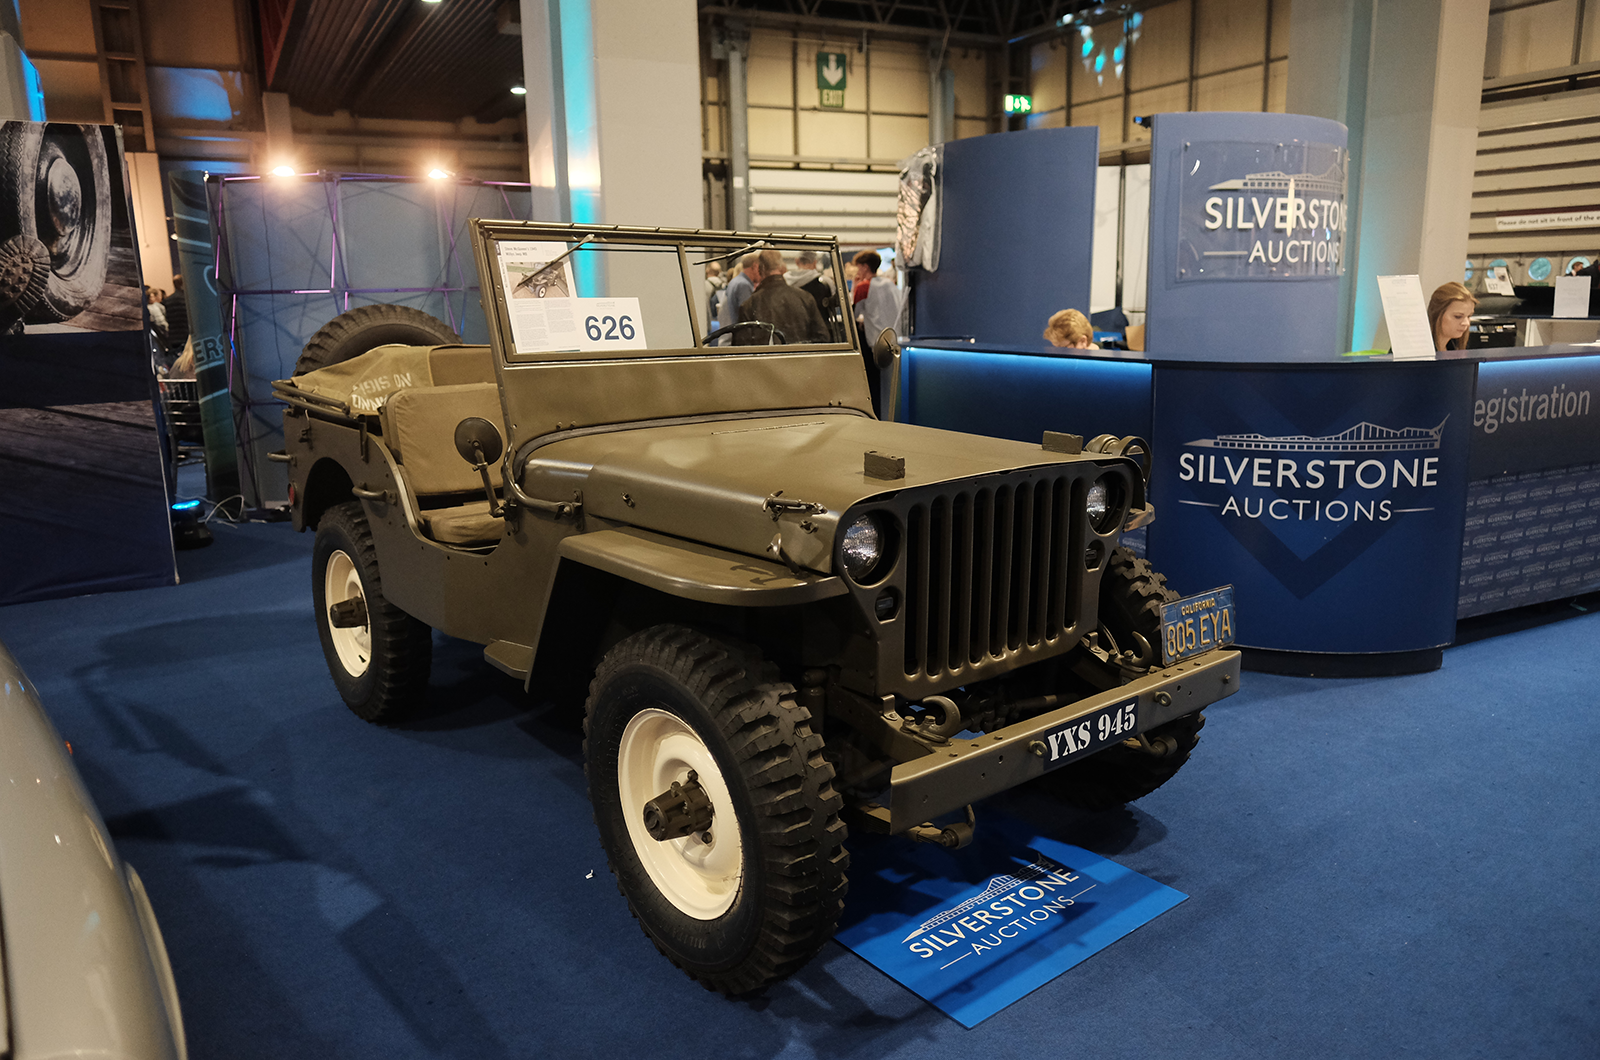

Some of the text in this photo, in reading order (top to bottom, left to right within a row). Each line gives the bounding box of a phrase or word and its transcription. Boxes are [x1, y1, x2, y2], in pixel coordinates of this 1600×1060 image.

[1248, 240, 1339, 263] AUCTIONS
[585, 315, 635, 341] 626
[1473, 383, 1591, 434] egistration
[1179, 452, 1439, 489] SILVERSTONE
[1221, 496, 1392, 521] AUCTIONS
[1181, 597, 1216, 616] CALIFORNIA
[1167, 609, 1232, 656] 805 EYA
[1047, 703, 1136, 761] YXS 945
[909, 868, 1080, 959] SILVERSTONE
[971, 895, 1075, 956] AUCTIONS
